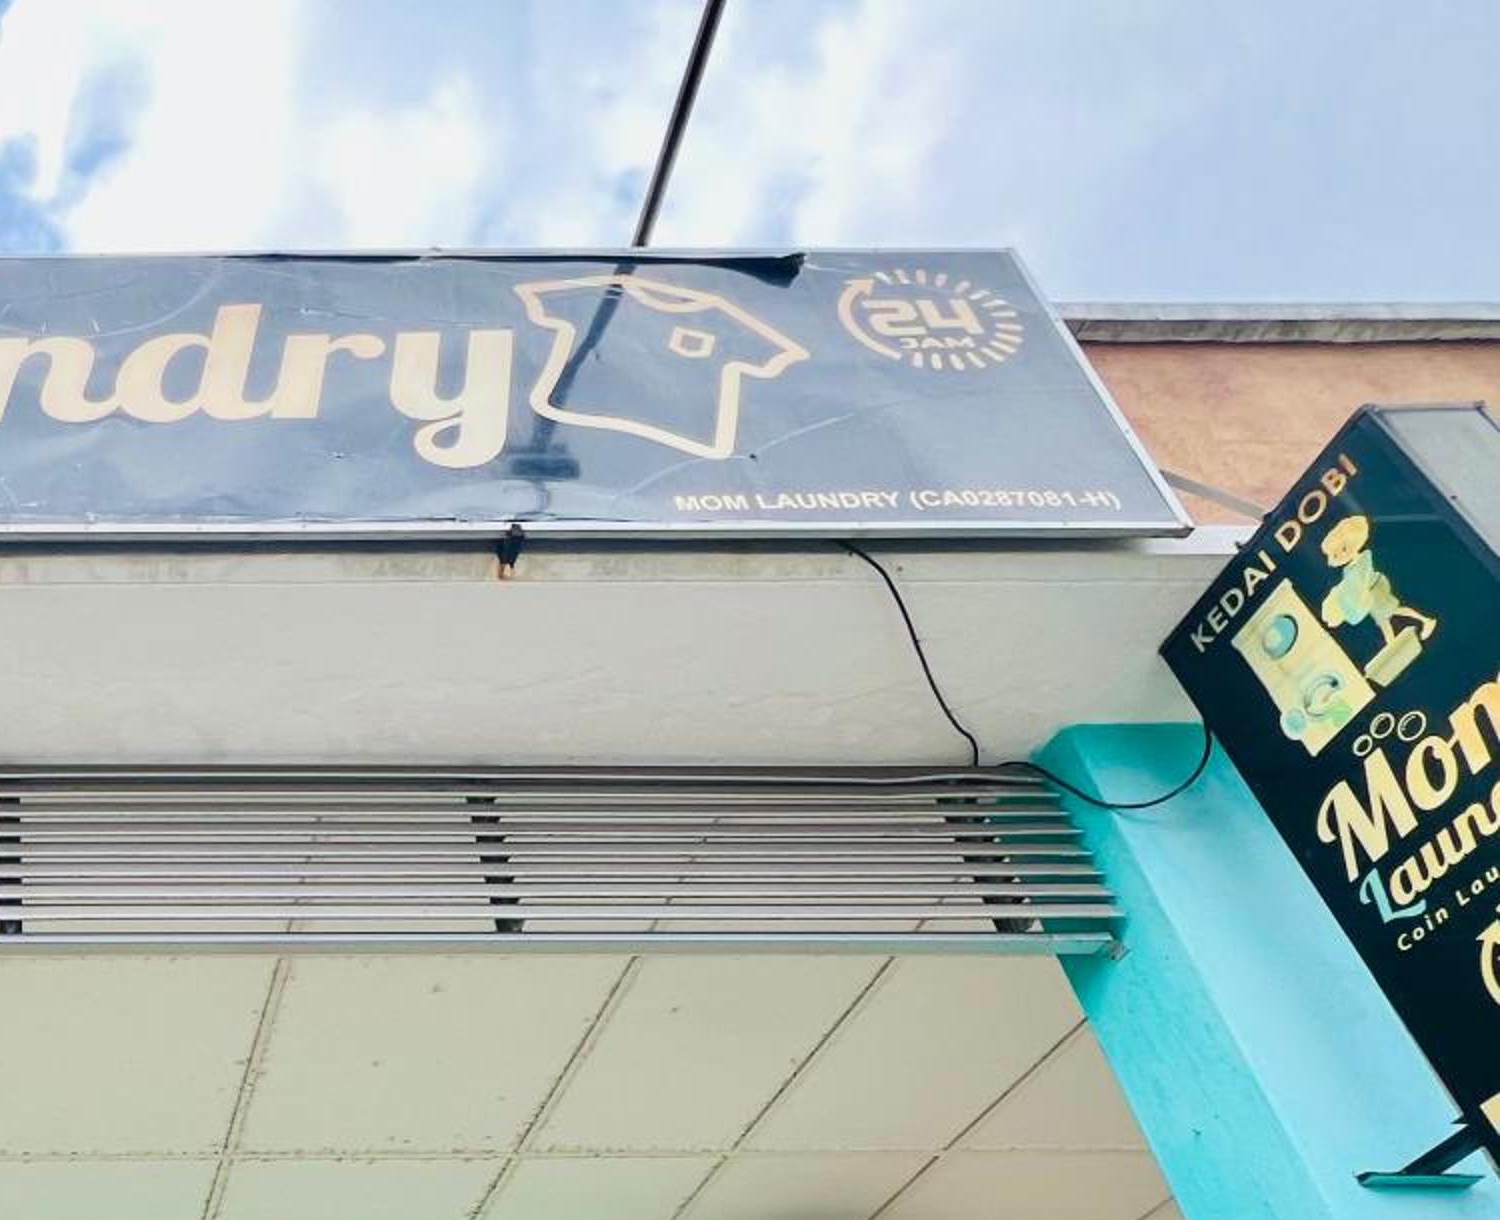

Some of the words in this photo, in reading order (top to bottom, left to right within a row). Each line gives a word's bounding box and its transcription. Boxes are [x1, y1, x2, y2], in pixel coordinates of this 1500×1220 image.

[862, 299, 984, 337] 24
[900, 336, 976, 350] JAM
[674, 493, 750, 513] MOM
[754, 490, 899, 511] LAUNDRY
[1190, 550, 1277, 653] KEDAI
[1274, 453, 1357, 553] DOBI
[1397, 907, 1449, 951] Coin
